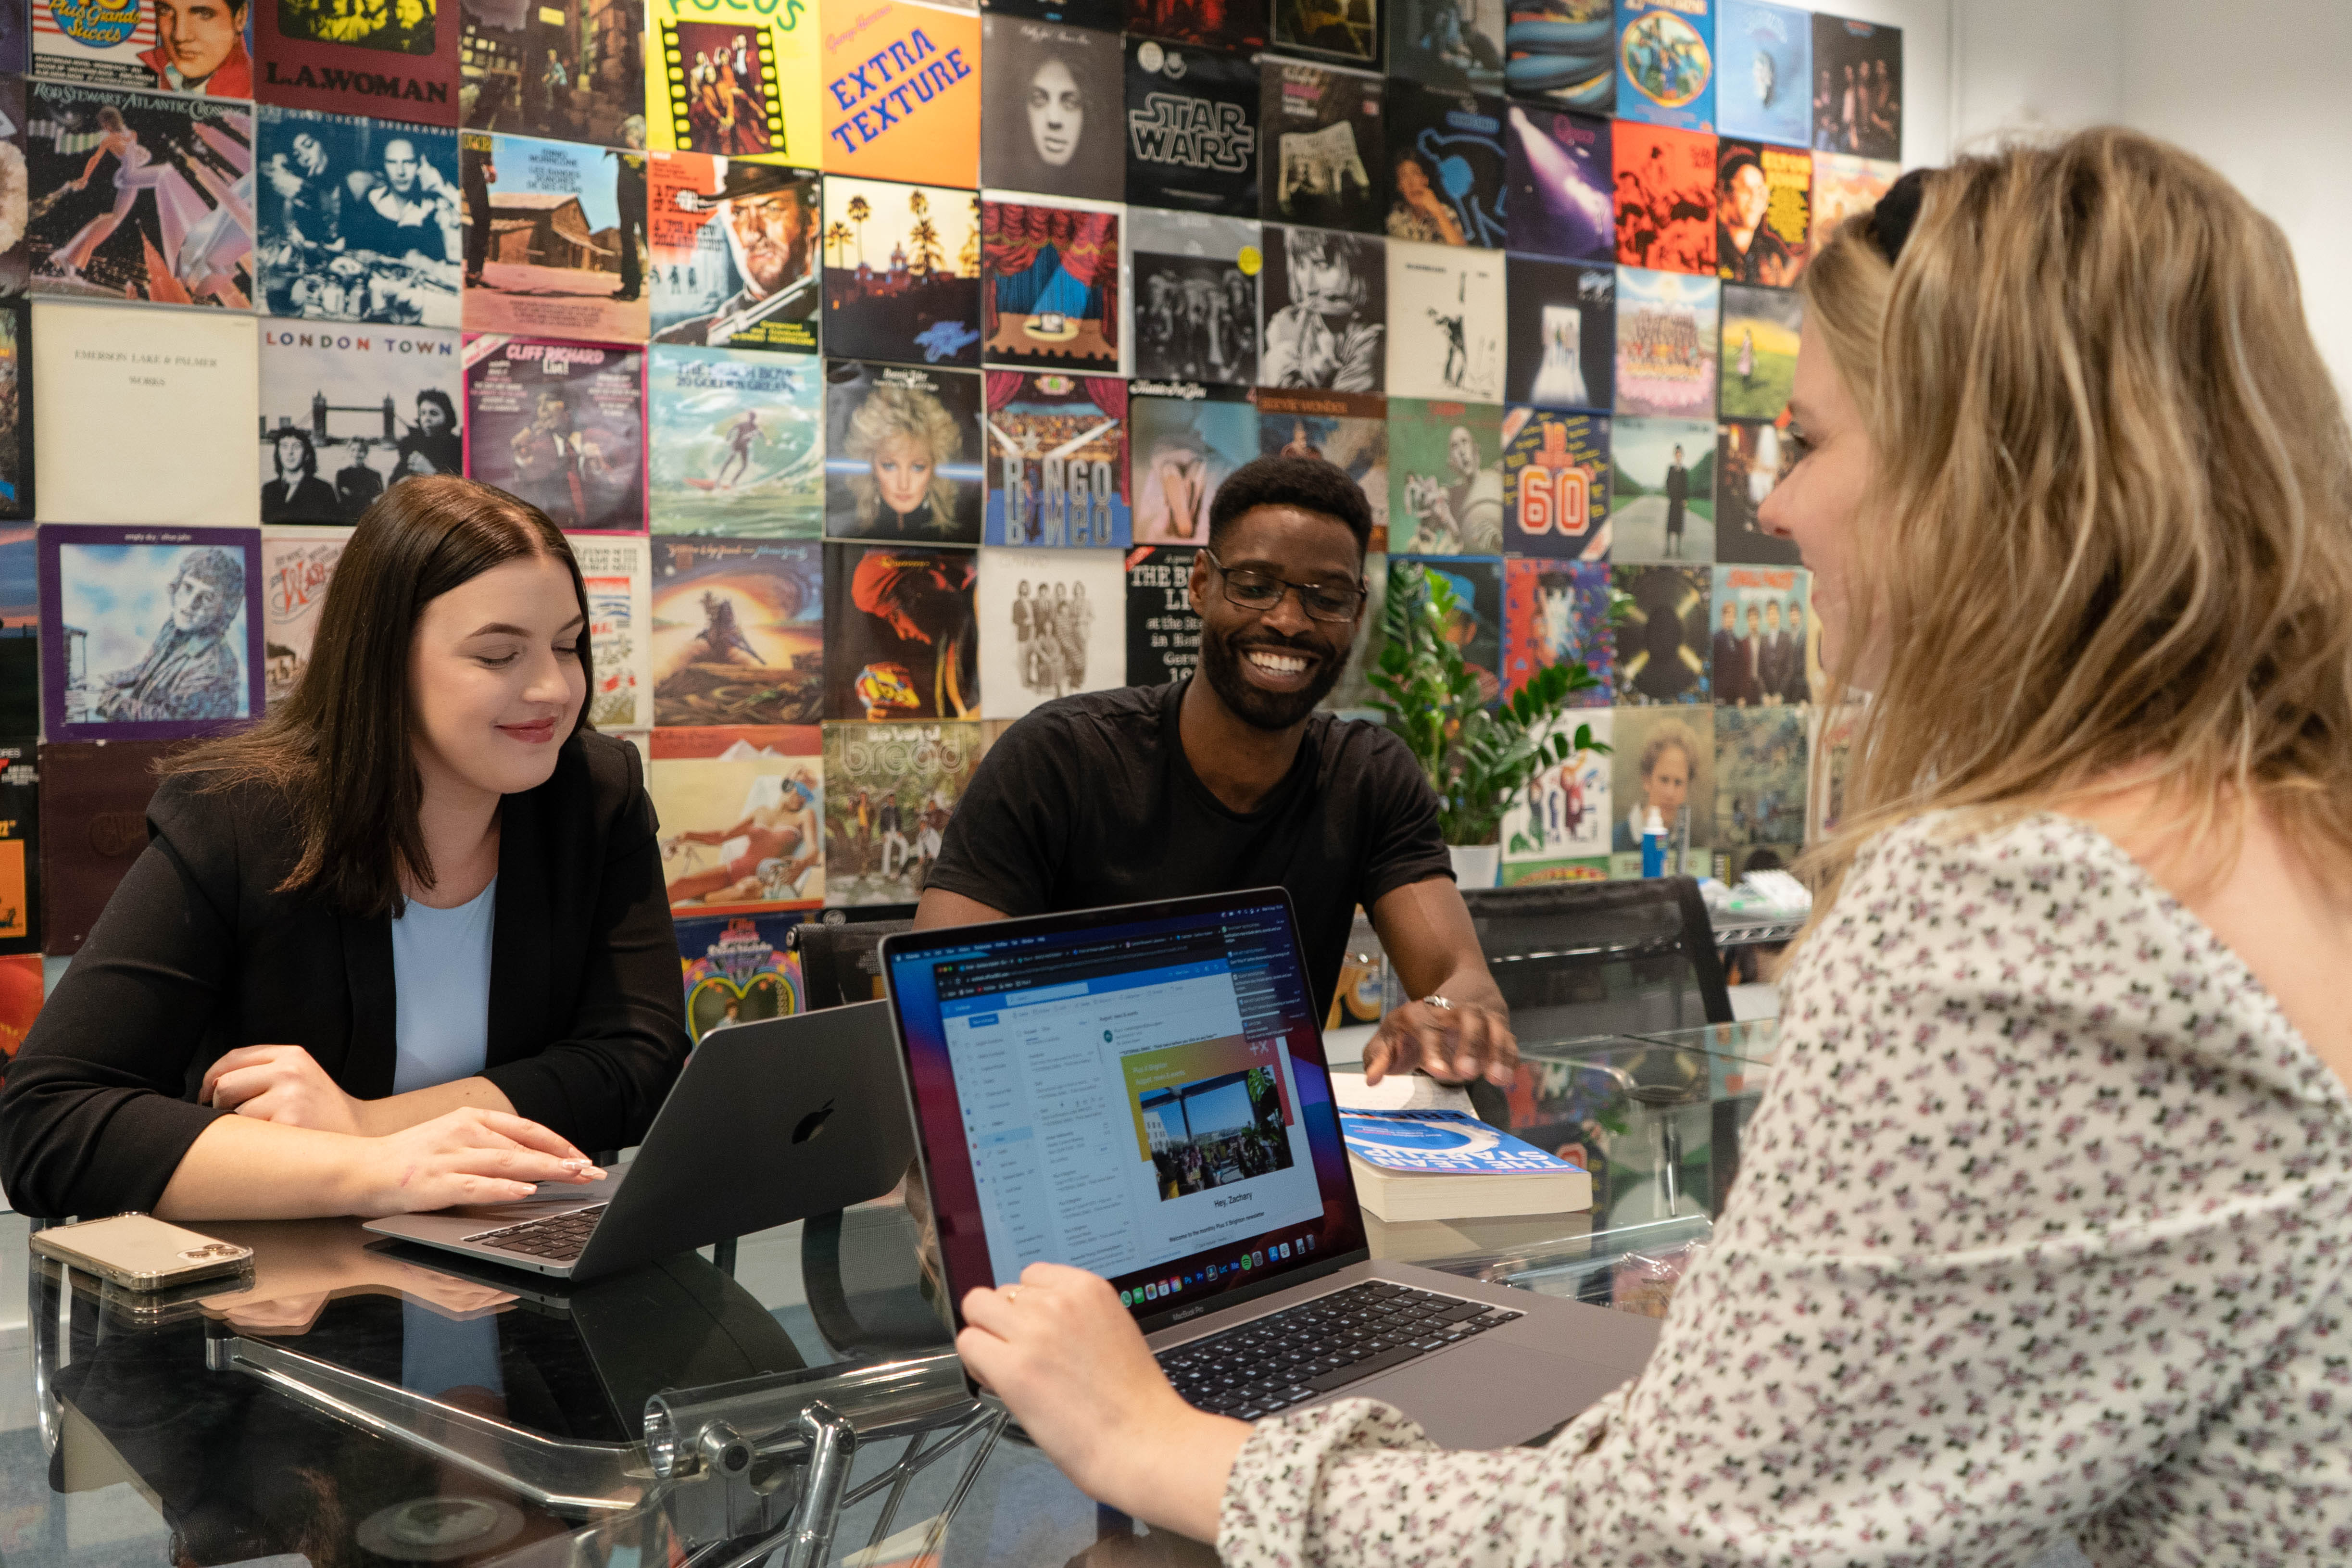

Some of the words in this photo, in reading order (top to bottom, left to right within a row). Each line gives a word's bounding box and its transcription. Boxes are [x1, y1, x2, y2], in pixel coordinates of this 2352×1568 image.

[87, 6, 141, 26] Grands
[829, 28, 937, 112] EXTRA
[34, 81, 63, 101] ROD
[60, 85, 122, 104] STEWART
[120, 93, 190, 113] ATLANTIC
[830, 48, 972, 155] TEXTURE
[1130, 91, 1254, 138] STAR
[1130, 120, 1255, 174] WARS
[266, 331, 370, 351] LONDON
[385, 338, 452, 355] TOWN
[74, 349, 127, 362] EMERSON
[131, 352, 160, 364] LAKE
[175, 355, 217, 367] PALMER
[505, 343, 544, 361] CLIFF
[544, 345, 605, 365] RICHARD
[1517, 464, 1590, 537] 60
[1131, 564, 1171, 588] THE
[1161, 615, 1183, 630] the
[839, 723, 968, 776] bread
[1371, 1156, 1480, 1170] LEAN
[1484, 1160, 1569, 1170] THE
[1228, 1192, 1253, 1204] Zachary
[1228, 1217, 1245, 1226] Brighton
[1196, 1272, 1204, 1280] Pr
[1231, 1262, 1239, 1270] Me
[1183, 1276, 1192, 1284] Ps
[1172, 1309, 1195, 1320] MacBook
